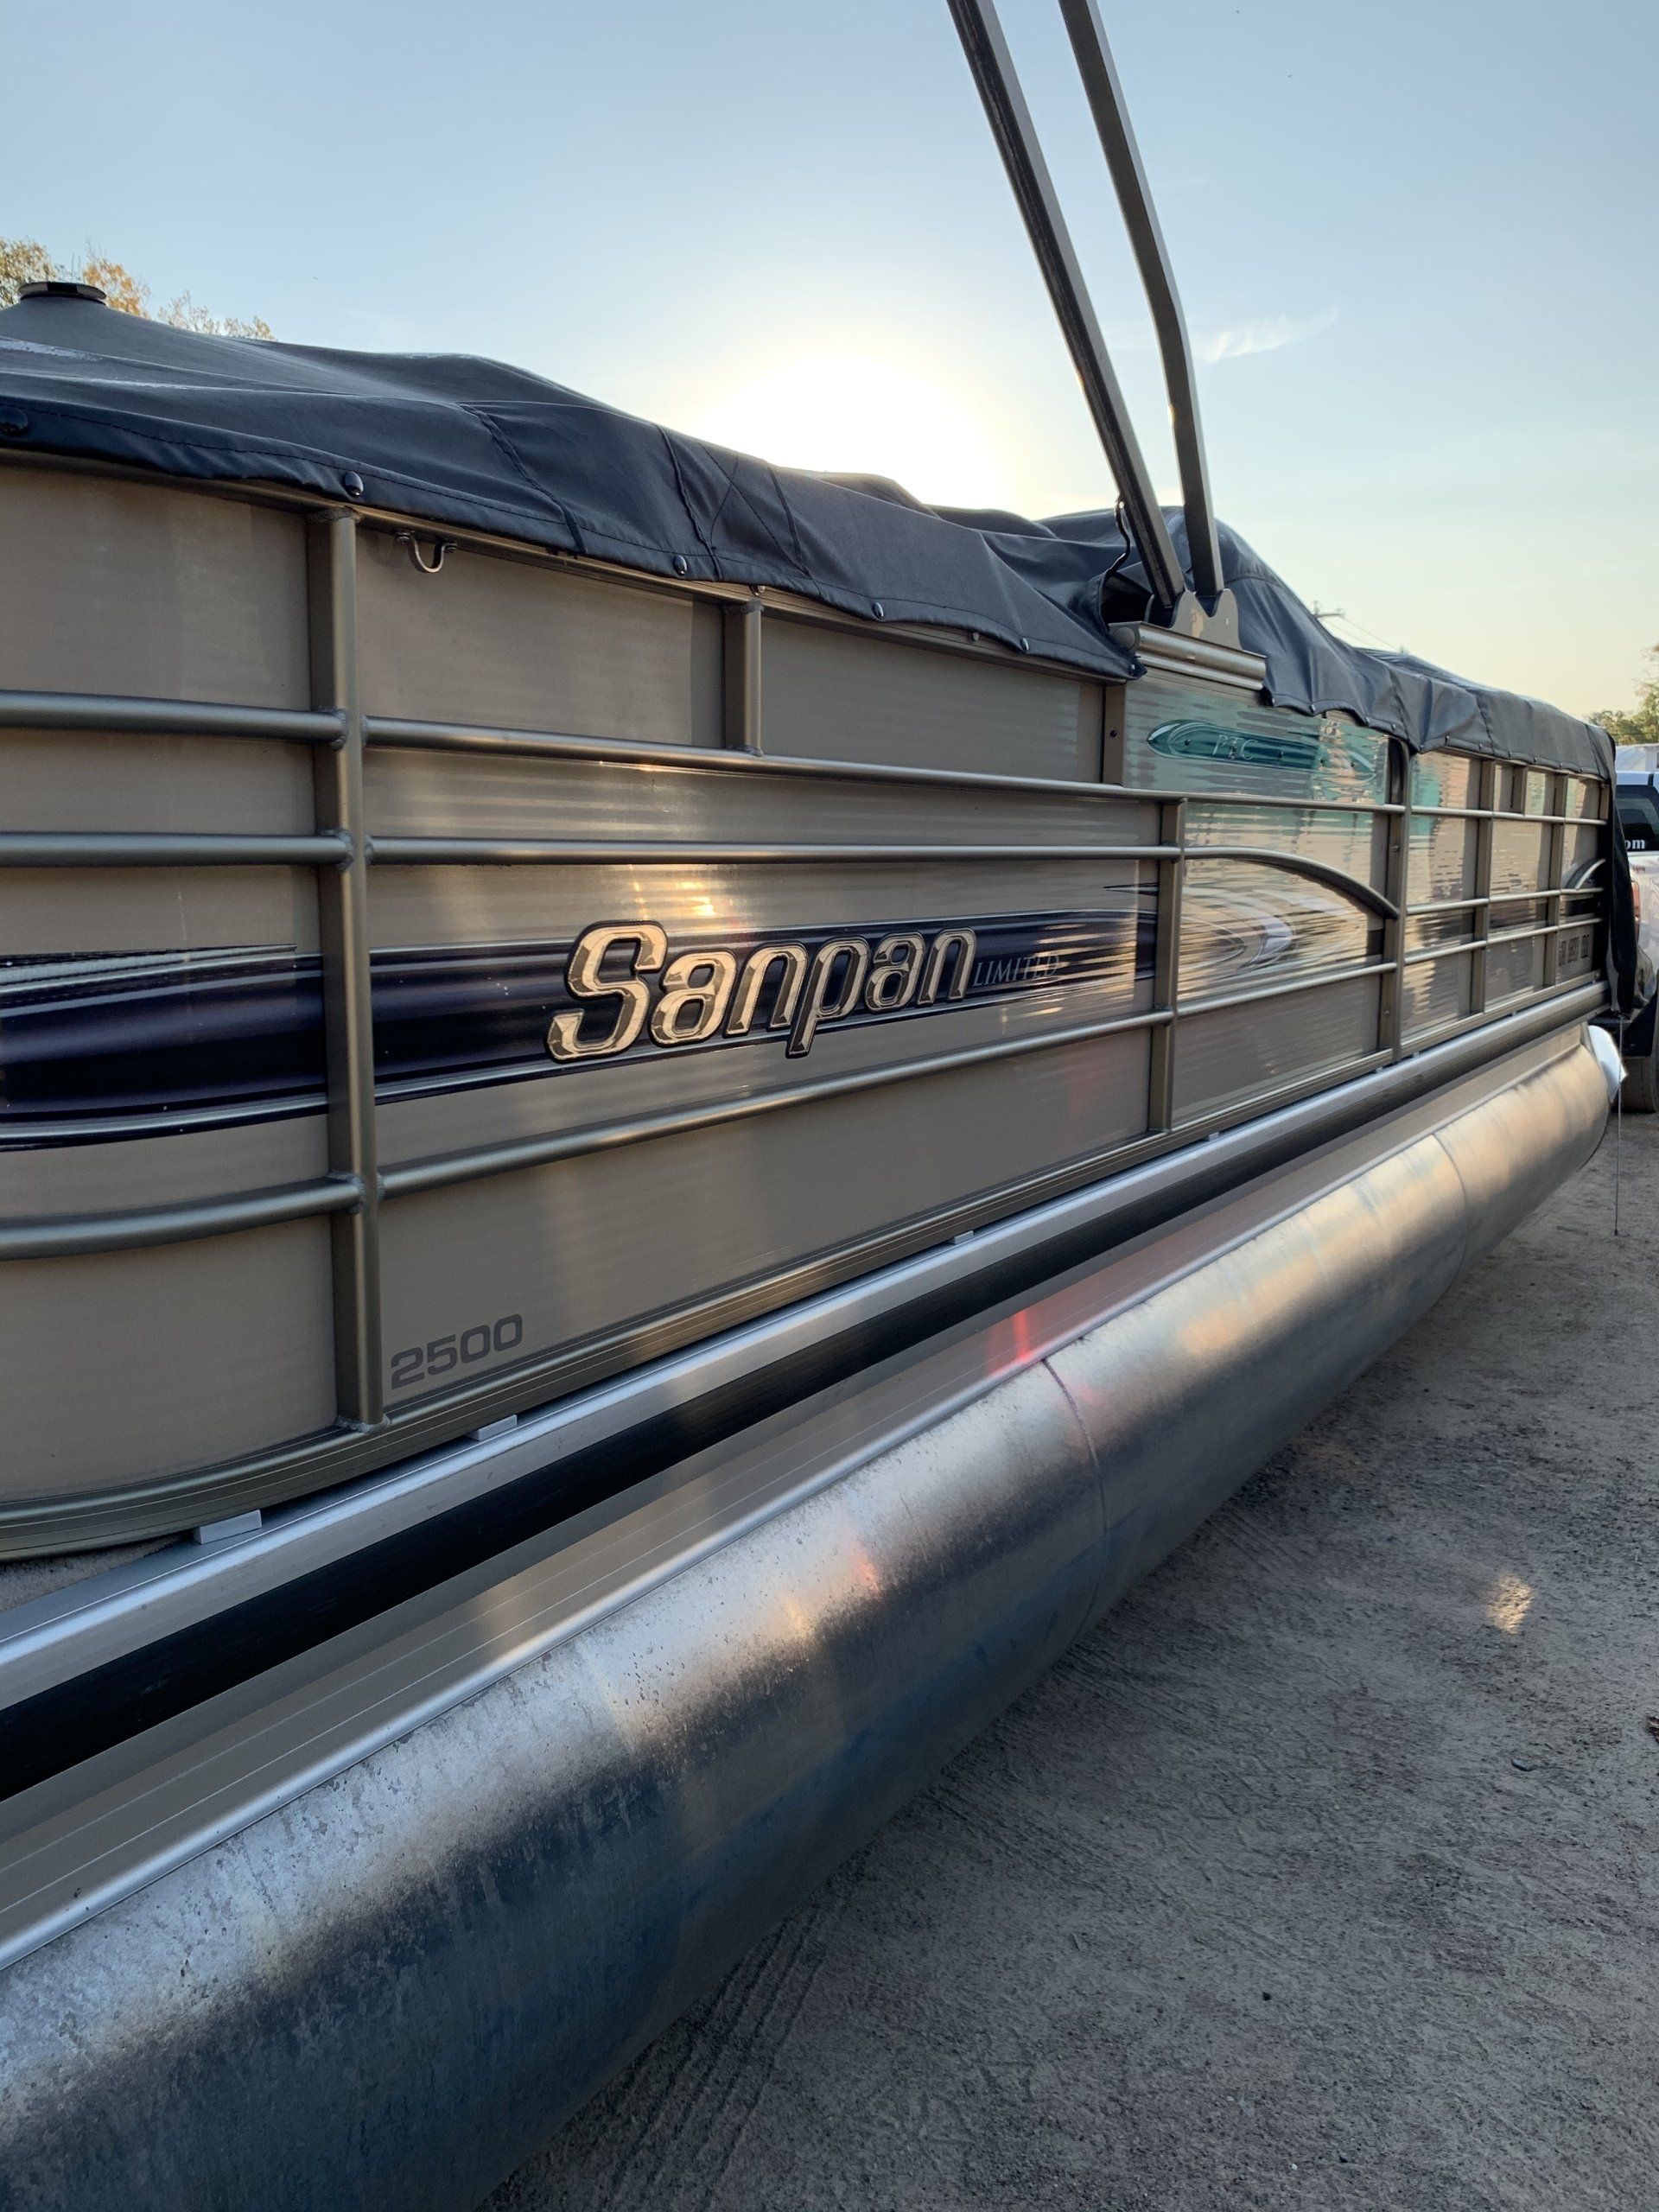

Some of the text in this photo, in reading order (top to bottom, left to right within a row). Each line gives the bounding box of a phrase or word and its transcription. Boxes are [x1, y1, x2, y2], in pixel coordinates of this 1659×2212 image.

[545, 920, 1060, 1062] Sanpan LIMITED
[391, 1313, 523, 1390] 2500
